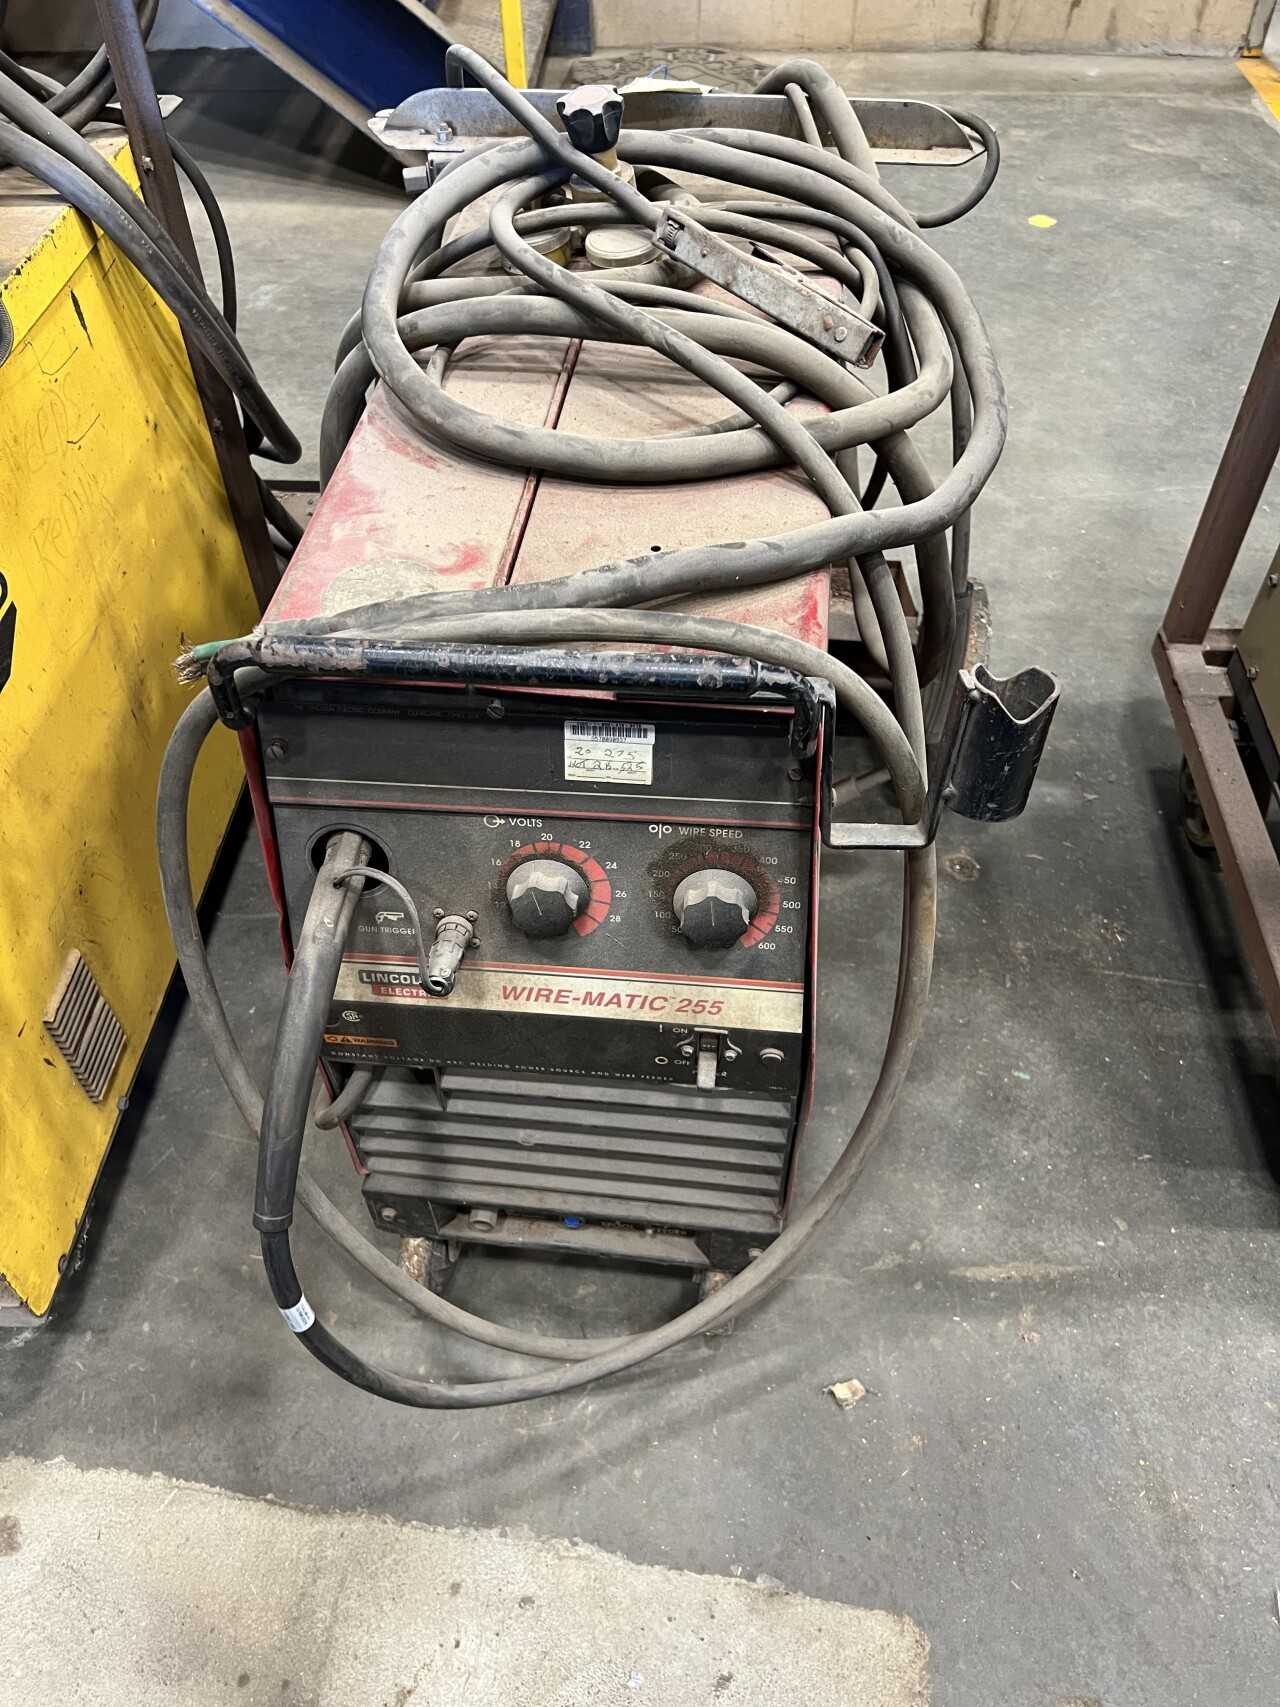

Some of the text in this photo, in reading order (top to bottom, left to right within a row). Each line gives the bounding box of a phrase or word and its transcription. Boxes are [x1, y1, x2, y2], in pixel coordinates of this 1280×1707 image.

[508, 818, 543, 828] VOLTS
[541, 833, 553, 841] 20
[679, 826, 743, 839] WIRE SPEED
[510, 840, 521, 848] 18
[578, 841, 591, 849] 22
[491, 858, 502, 866] 16
[606, 861, 617, 870] 24
[615, 890, 627, 898] 26
[782, 900, 801, 909] 500
[655, 910, 671, 919] 100
[358, 925, 377, 934] GUN
[775, 925, 793, 933] 550
[758, 942, 776, 951] 600
[362, 972, 423, 986] LINCOL
[381, 986, 431, 998] ELECTR
[501, 985, 725, 1016] WIRE-MATIC 255
[672, 1027, 689, 1035] ON
